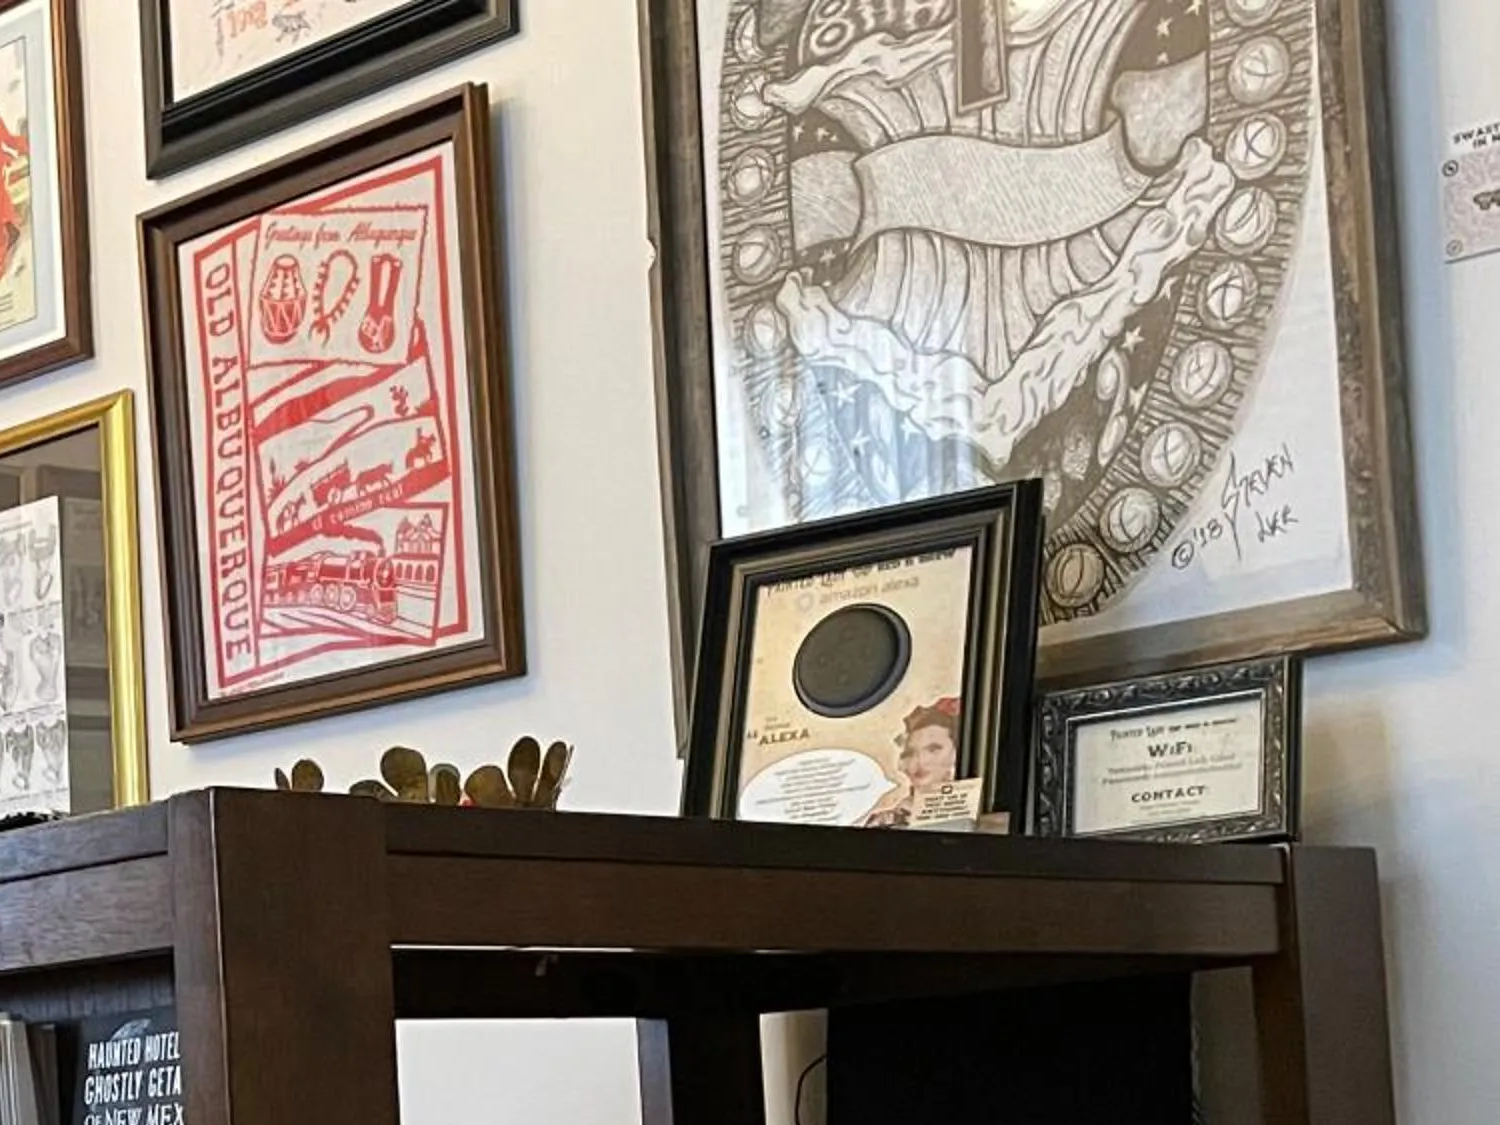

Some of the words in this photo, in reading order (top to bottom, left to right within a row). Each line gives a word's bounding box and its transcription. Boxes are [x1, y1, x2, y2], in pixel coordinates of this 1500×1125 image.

[205, 263, 235, 338] OLD
[211, 355, 251, 661] ALBUQUERQUE
[759, 728, 811, 746] ALEXA
[87, 1037, 141, 1070] HAUNTED
[145, 1031, 181, 1062] HOTEL
[84, 1071, 143, 1105] GHOSTLY
[147, 1065, 182, 1098] GETA
